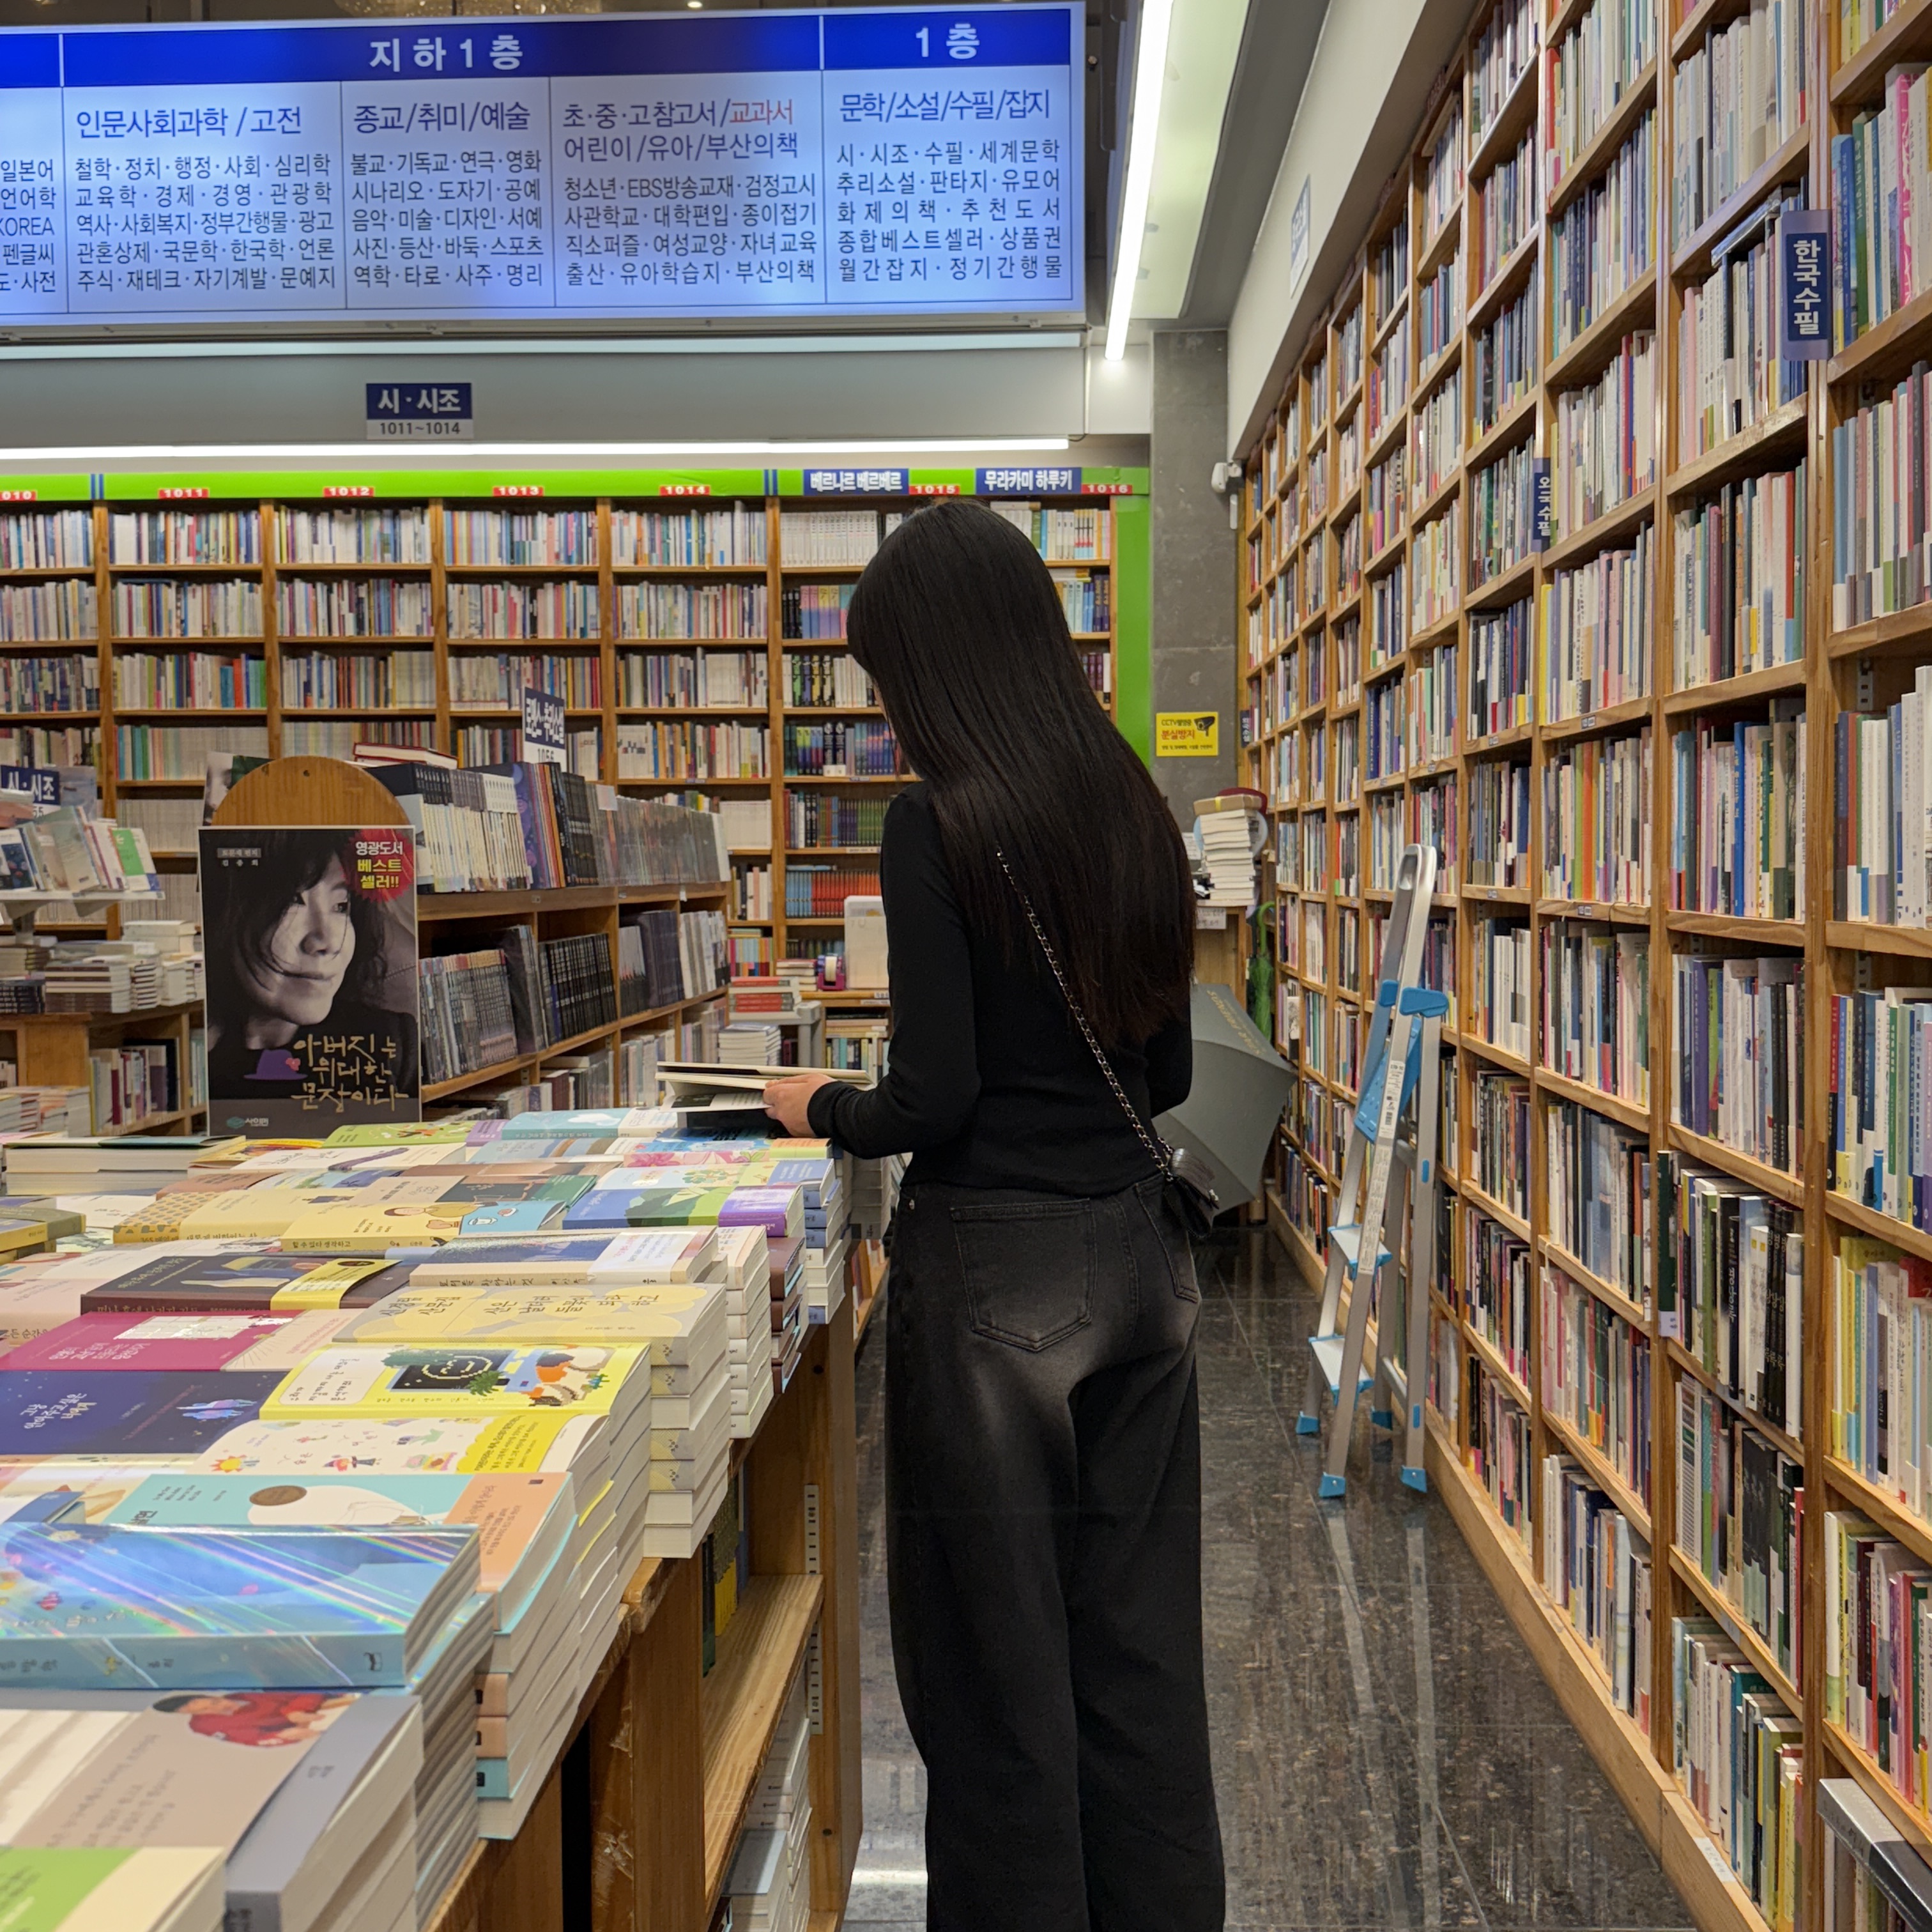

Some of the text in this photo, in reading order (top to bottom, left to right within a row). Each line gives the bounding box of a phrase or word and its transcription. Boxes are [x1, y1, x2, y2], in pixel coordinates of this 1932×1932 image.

[839, 89, 1049, 123] 문학/소설/수필/잡지
[353, 102, 530, 134] 종교/취미/예술
[564, 132, 798, 163] 어린이/유아/부산의책
[1, 160, 54, 182] 일본어
[1, 187, 56, 210] 언어학
[1793, 240, 1821, 335] 한국수필
[380, 422, 461, 436] 1011~1014
[665, 485, 706, 494] 1014
[810, 471, 855, 492] 베르나르
[985, 470, 1073, 491] 무라카미 하루키
[1087, 484, 1128, 494] 1016
[164, 488, 204, 498] 1011
[329, 487, 369, 496] 1012
[499, 486, 539, 496] 1013
[914, 486, 956, 494] 1015
[355, 841, 403, 855] 영광도서
[357, 859, 402, 872] 베스트
[360, 875, 399, 889] 셀러!!
[312, 1056, 392, 1087] 위대한
[291, 1082, 409, 1112] 문장이다
[379, 1297, 422, 1315] 신경림
